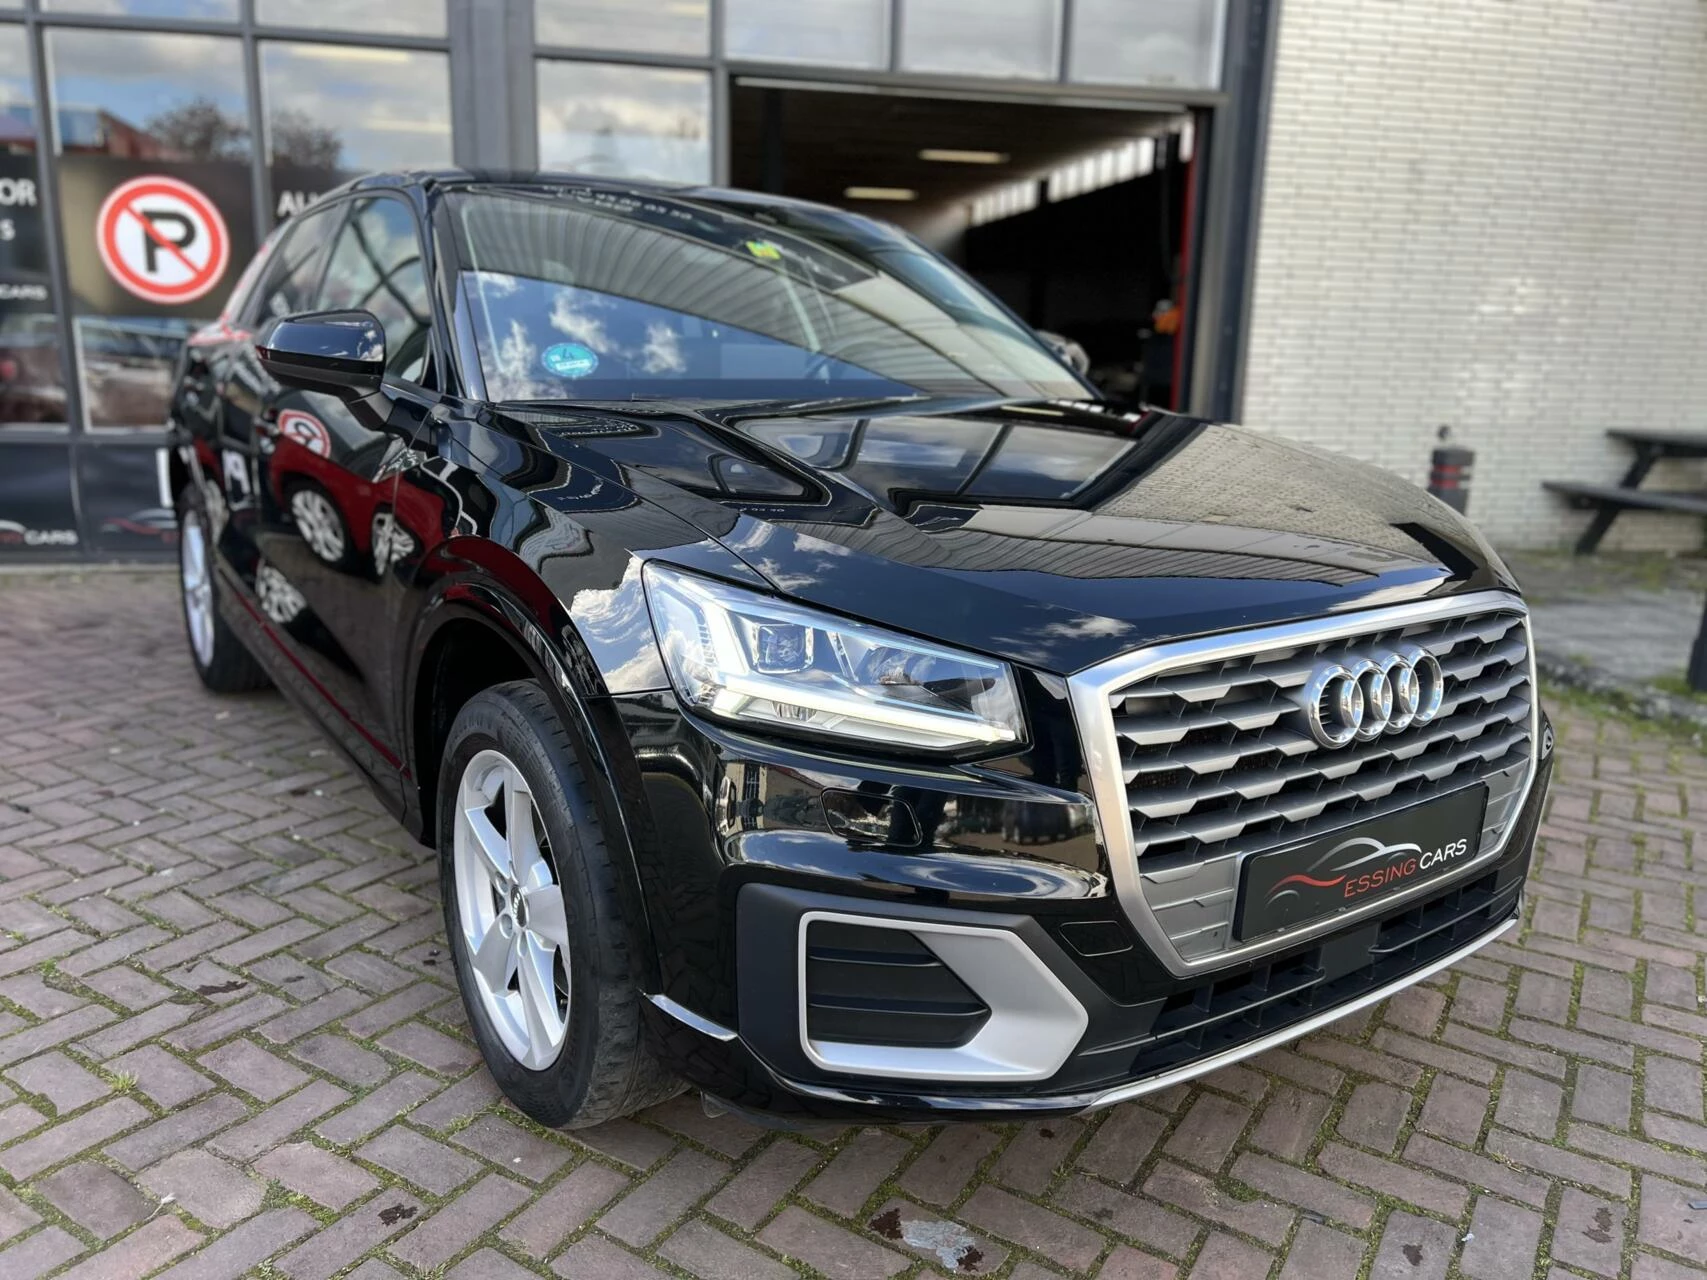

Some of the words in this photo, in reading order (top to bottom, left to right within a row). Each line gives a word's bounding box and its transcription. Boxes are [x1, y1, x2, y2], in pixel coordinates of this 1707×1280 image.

[142, 209, 196, 272] P
[24, 529, 79, 546] CARS
[1344, 857, 1417, 898] ESSING
[1419, 838, 1467, 870] CARS
